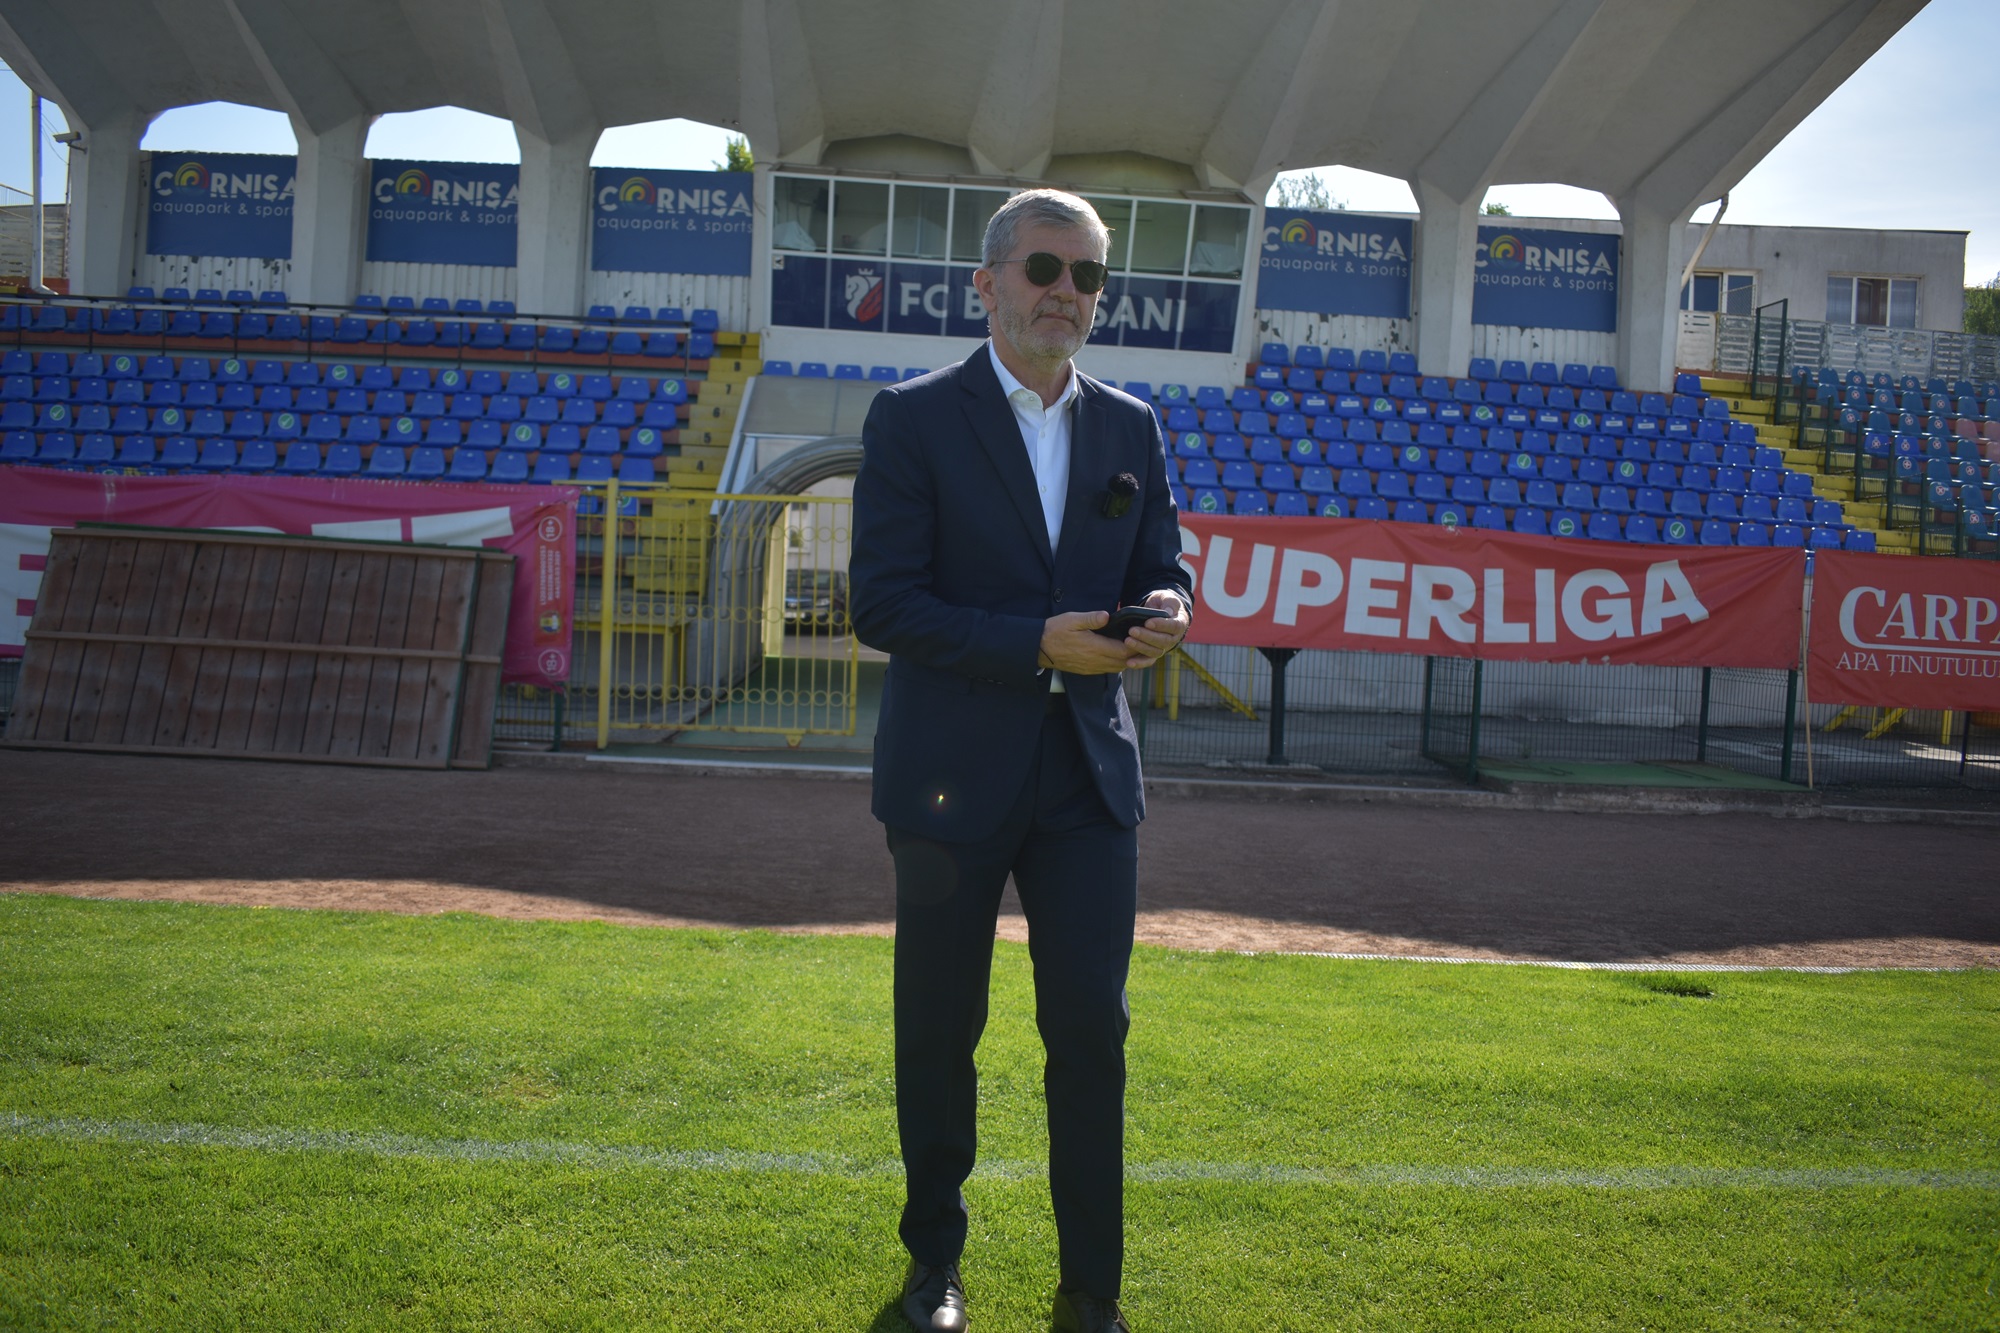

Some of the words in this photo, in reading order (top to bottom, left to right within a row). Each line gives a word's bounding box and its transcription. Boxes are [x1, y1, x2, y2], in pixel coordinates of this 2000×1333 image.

[153, 202, 231, 215] aquapark
[238, 203, 248, 215] &
[255, 205, 294, 218] spor
[373, 209, 453, 223] aquapark
[460, 210, 470, 222] &
[597, 217, 679, 232] aquapark
[686, 219, 697, 231] &
[704, 220, 753, 234] sports
[1260, 257, 1338, 272] aquapark
[1345, 261, 1355, 273] &
[1361, 264, 1408, 277] sports
[1552, 276, 1562, 288] &
[1569, 279, 1615, 292] sports
[900, 282, 949, 319] FC
[725, 384, 731, 395] 7
[713, 407, 720, 418] 6
[704, 432, 711, 443] 5
[545, 519, 556, 538] 18+
[1839, 586, 2000, 650] CARP
[546, 653, 558, 672] 18+
[1836, 651, 1880, 672] APA
